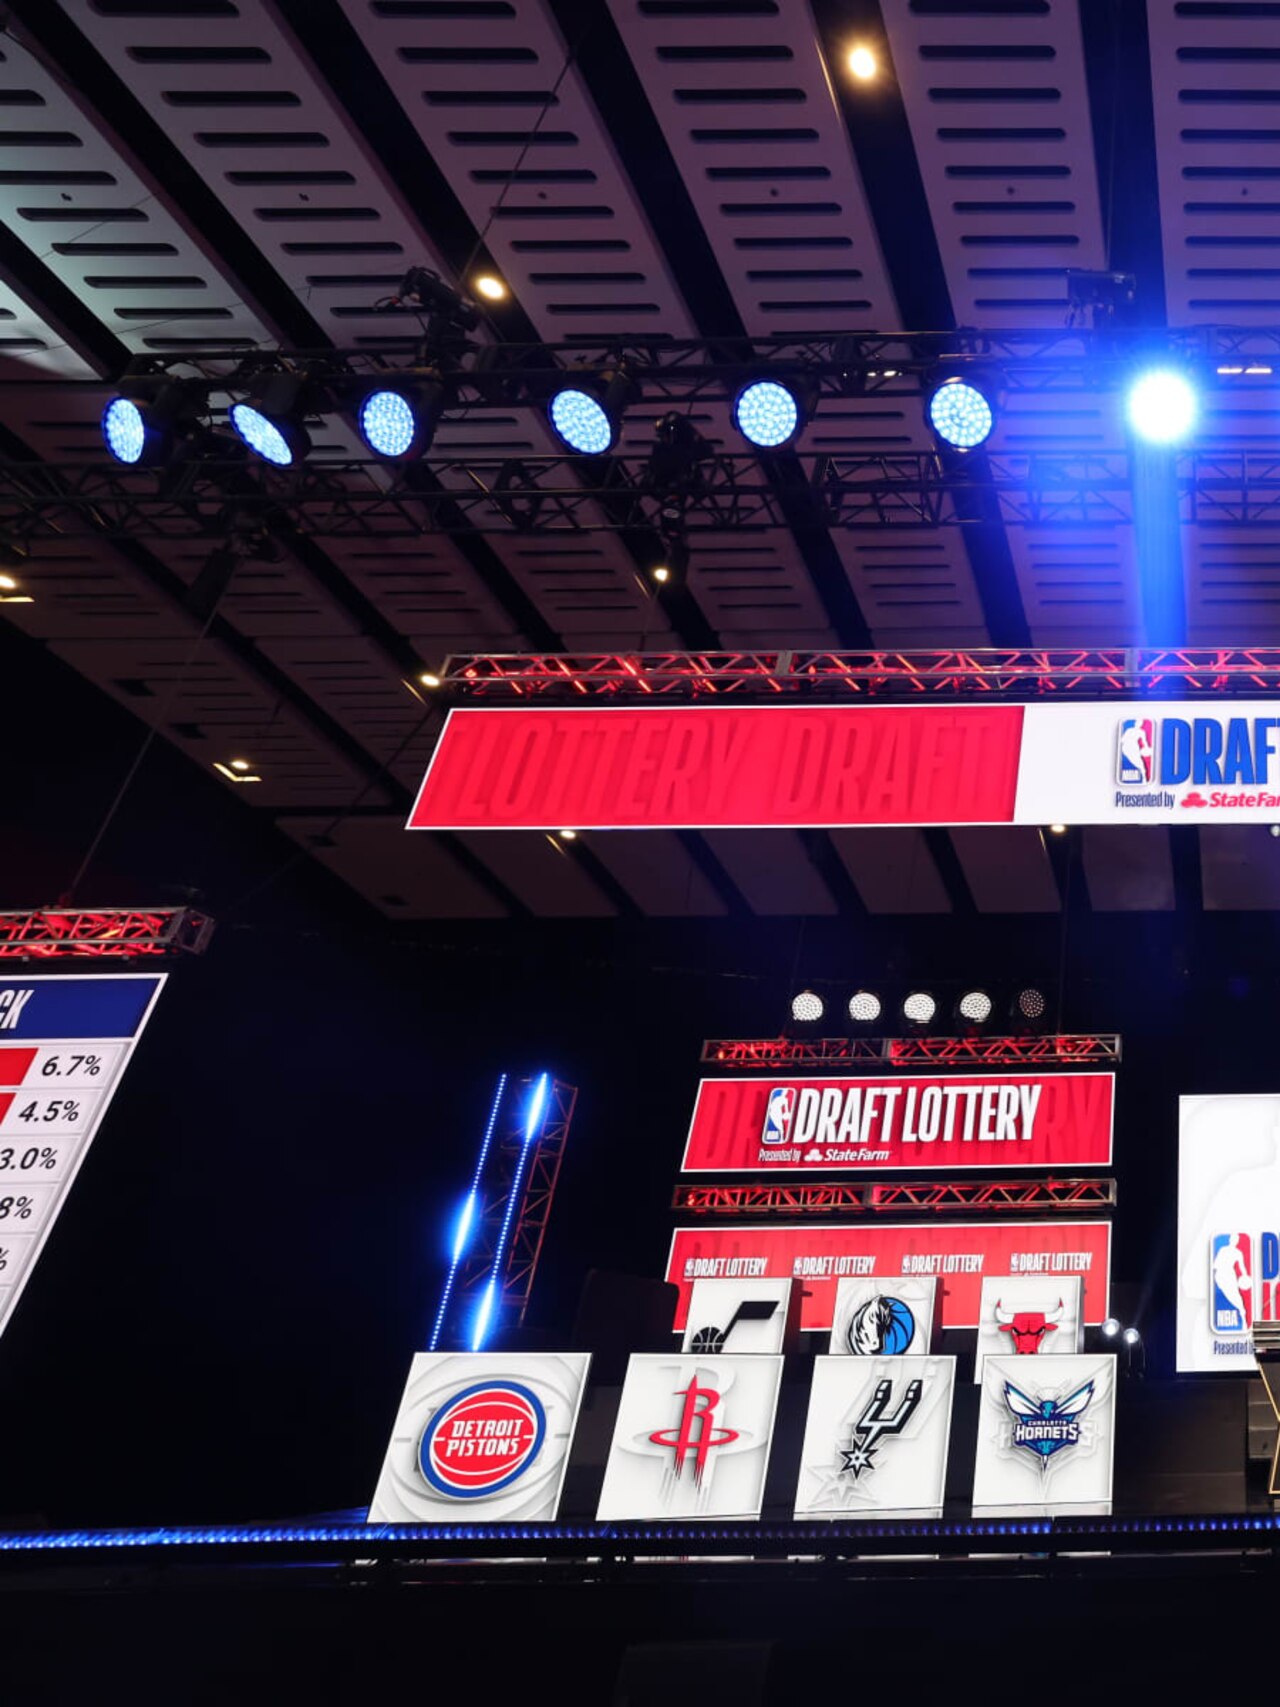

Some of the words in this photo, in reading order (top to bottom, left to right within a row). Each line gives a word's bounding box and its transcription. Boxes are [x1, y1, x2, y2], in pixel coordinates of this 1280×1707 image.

[459, 718, 751, 818] LOTTERY
[776, 714, 996, 817] DRAFT
[1115, 791, 1163, 808] Presented
[1165, 791, 1175, 809] by
[42, 1055, 101, 1076] 6.7%
[18, 1100, 80, 1122] 4.5%
[791, 1086, 903, 1143] DRAFT
[902, 1085, 1042, 1142] LOTTERY
[694, 1258, 726, 1276] DRAFT
[726, 1258, 768, 1276] LOTTERY
[802, 1257, 833, 1275] DRAFT
[834, 1256, 876, 1274] LOTTERY
[911, 1255, 942, 1273] DRAFT
[943, 1254, 984, 1272] LOTTERY
[1020, 1253, 1051, 1271] DRAFT
[1051, 1252, 1092, 1270] LOTTERY
[451, 1419, 524, 1437] DETROIT
[1016, 1423, 1078, 1441] HORNETS
[445, 1438, 520, 1457] PISTONS
